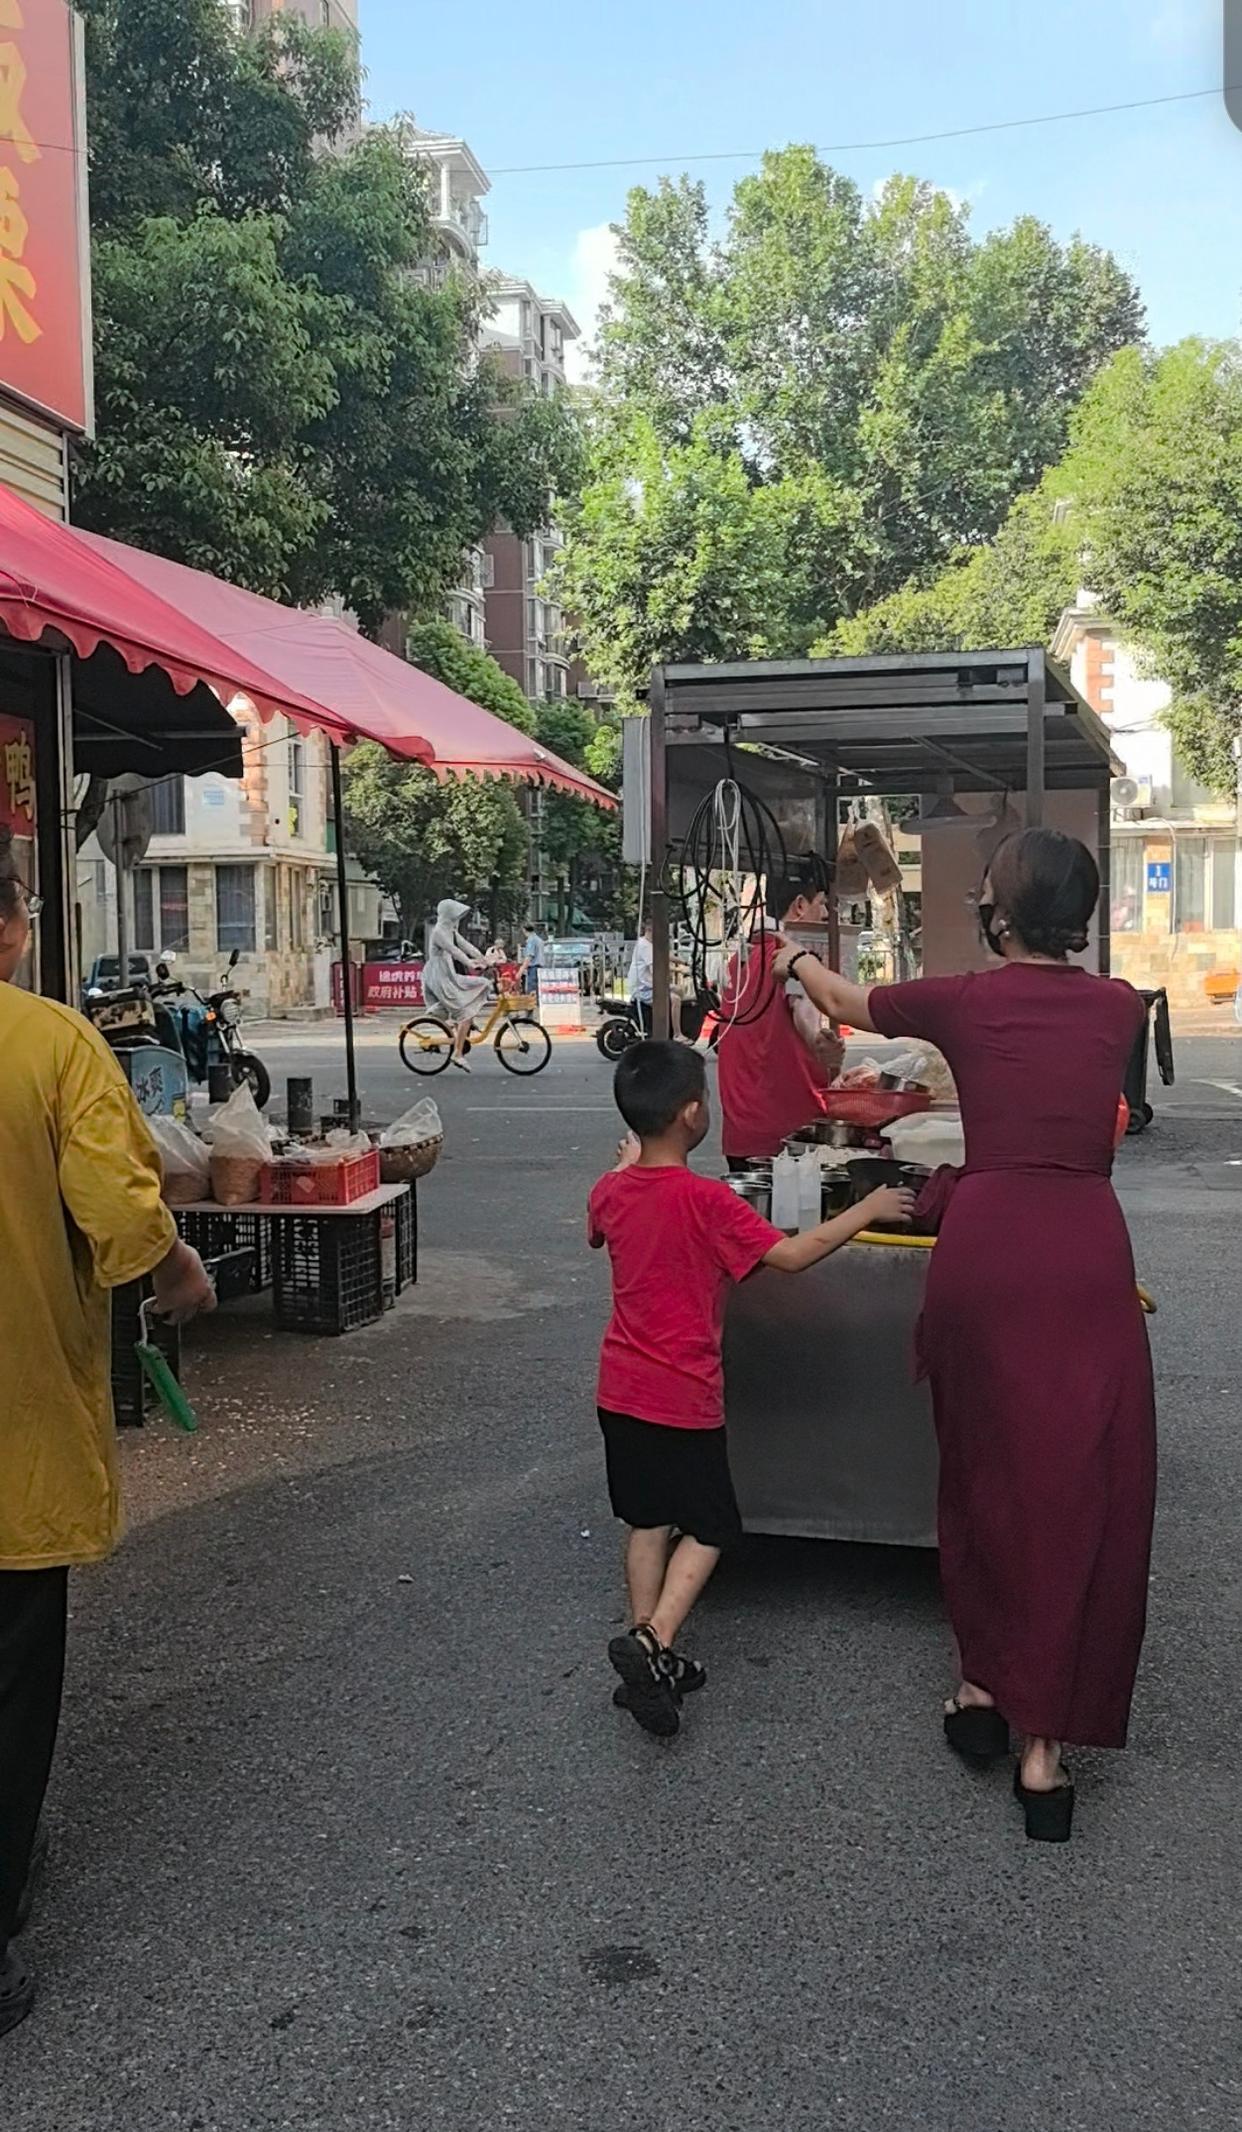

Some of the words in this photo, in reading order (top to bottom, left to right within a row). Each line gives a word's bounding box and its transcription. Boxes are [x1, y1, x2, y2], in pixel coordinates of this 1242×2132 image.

[5, 730, 33, 820] 鸭
[1155, 865, 1161, 877] 1
[367, 985, 417, 999] 政府补贴
